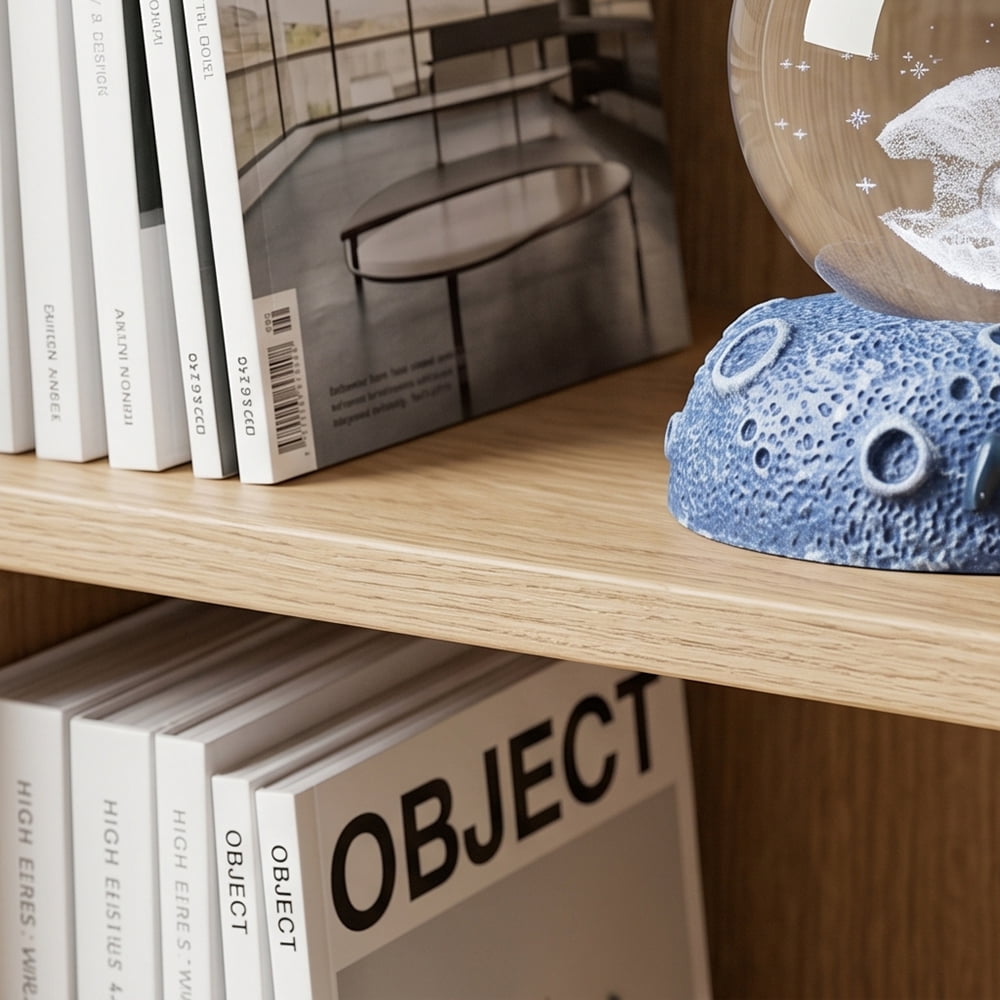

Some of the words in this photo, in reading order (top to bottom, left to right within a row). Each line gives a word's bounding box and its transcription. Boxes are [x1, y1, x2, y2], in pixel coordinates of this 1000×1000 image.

[17, 779, 34, 845] HIGH
[103, 799, 120, 865] HIGH
[172, 809, 189, 870] HIGH
[331, 672, 660, 932] OBJECT
[225, 829, 249, 935] OBJECT
[271, 844, 297, 952] OBJECT
